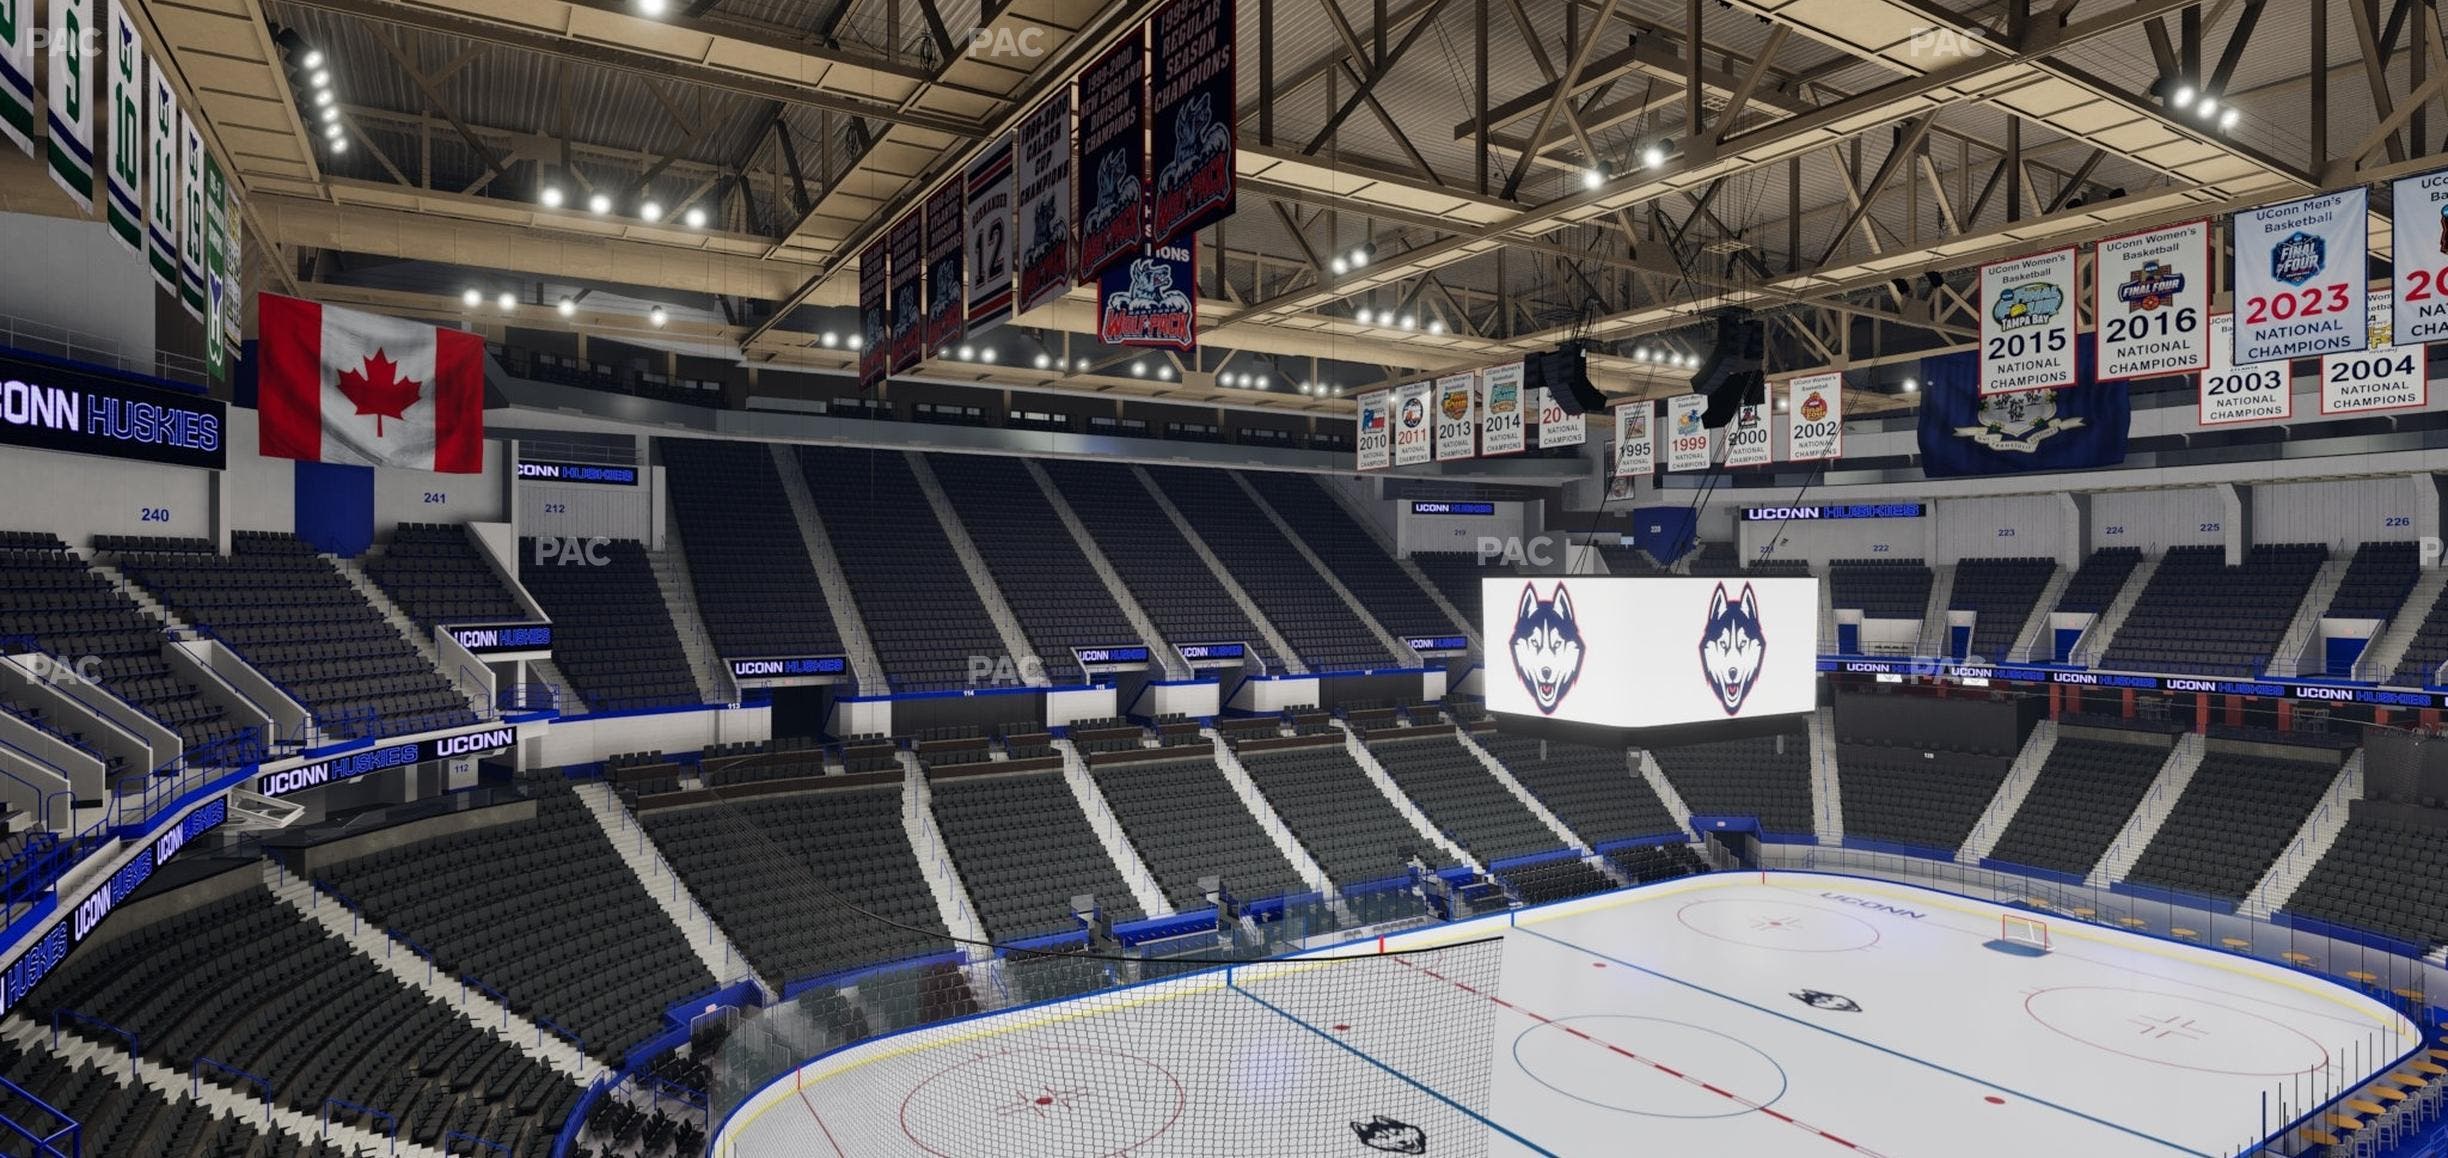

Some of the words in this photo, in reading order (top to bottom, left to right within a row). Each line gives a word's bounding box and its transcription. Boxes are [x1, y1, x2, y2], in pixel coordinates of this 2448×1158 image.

[1154, 44, 1231, 114] CHAMPIONS
[115, 82, 137, 191] 10
[156, 139, 172, 232] 11
[2256, 205, 2299, 222] UConn
[2303, 196, 2342, 212] Men's
[2264, 212, 2332, 233] Basketball
[2106, 239, 2143, 252] UConn
[2145, 227, 2197, 244] Women's
[975, 216, 1005, 291] 12
[2122, 243, 2179, 261] Basketball
[2280, 242, 2316, 262] FINAL
[1988, 264, 2020, 276] UConn
[2022, 253, 2066, 269] Women's
[2283, 254, 2320, 273] FOUR
[2002, 268, 2051, 284] Basketball
[2123, 283, 2151, 298] FINAL
[2151, 279, 2181, 294] FOUR
[2246, 283, 2350, 325] 2023
[2002, 316, 2031, 332] TAMPA
[2031, 314, 2050, 326] BAY
[2106, 307, 2196, 343] 2016
[2255, 320, 2343, 341] NATIONAL
[1988, 328, 2066, 360] 2015
[2117, 340, 2191, 358] NATIONAL
[2248, 336, 2351, 359] CHAMPIONS
[1997, 357, 2061, 374] NATIONAL
[2109, 354, 2198, 375] CHAMPIONS
[2330, 354, 2415, 383] 2004
[1990, 371, 2067, 390] CHAMPIONS
[2207, 370, 2282, 396] 2003
[2341, 381, 2409, 395] NATIONAL
[2216, 394, 2277, 408] NATIONAL
[2333, 393, 2416, 409] CHAMPIONS
[2209, 406, 2282, 421] CHAMPIONS
[87, 394, 218, 451] HUSKIES
[1439, 421, 1471, 439] 2013
[1485, 413, 1520, 433] 2014
[1548, 424, 1578, 434] NATIONAL
[1794, 421, 1837, 439] 2002
[1360, 434, 1387, 451] 2010
[1398, 428, 1427, 445] 2011
[1490, 432, 1519, 441] NATIONAL
[1544, 433, 1582, 445] CHAMPIONS
[1672, 436, 1707, 452] 1999
[1728, 429, 1767, 446] 2000
[1487, 442, 1521, 452] CHAMPIONS
[1620, 442, 1651, 457] 1995
[1733, 447, 1764, 455] NATIONAL
[1675, 452, 1704, 460] NATIONAL
[1729, 455, 1767, 464] CHAMPIONS
[518, 464, 559, 478] CONN
[424, 492, 446, 504] 241
[141, 507, 170, 522] 240
[544, 504, 566, 513] 212
[1415, 503, 1449, 512] UCONN
[1749, 507, 1819, 520] UCONN
[2106, 526, 2124, 535] 224
[2200, 523, 2220, 532] 225
[2385, 517, 2410, 527] 226
[1998, 528, 2015, 537] 223
[454, 629, 498, 647] UCONN
[1408, 639, 1434, 648] UCONN
[1079, 650, 1109, 661] UCONN
[1181, 646, 1208, 657] UCONN
[735, 660, 783, 675] UCONN
[1846, 663, 1890, 672] UCONN
[1951, 667, 1993, 677] UCONN
[2053, 673, 2098, 684] UCONN
[2166, 679, 2216, 692] UCONN
[2296, 686, 2352, 700] UCONN
[263, 762, 329, 798] UCONN
[331, 744, 419, 780] HUSKIES
[436, 728, 513, 757] UCONN
[454, 763, 469, 773] 112
[1820, 891, 1927, 919] UCONN
[7, 920, 68, 1008] HUSKIES
[74, 881, 111, 942] UCONN
[156, 822, 184, 866] UCONN
